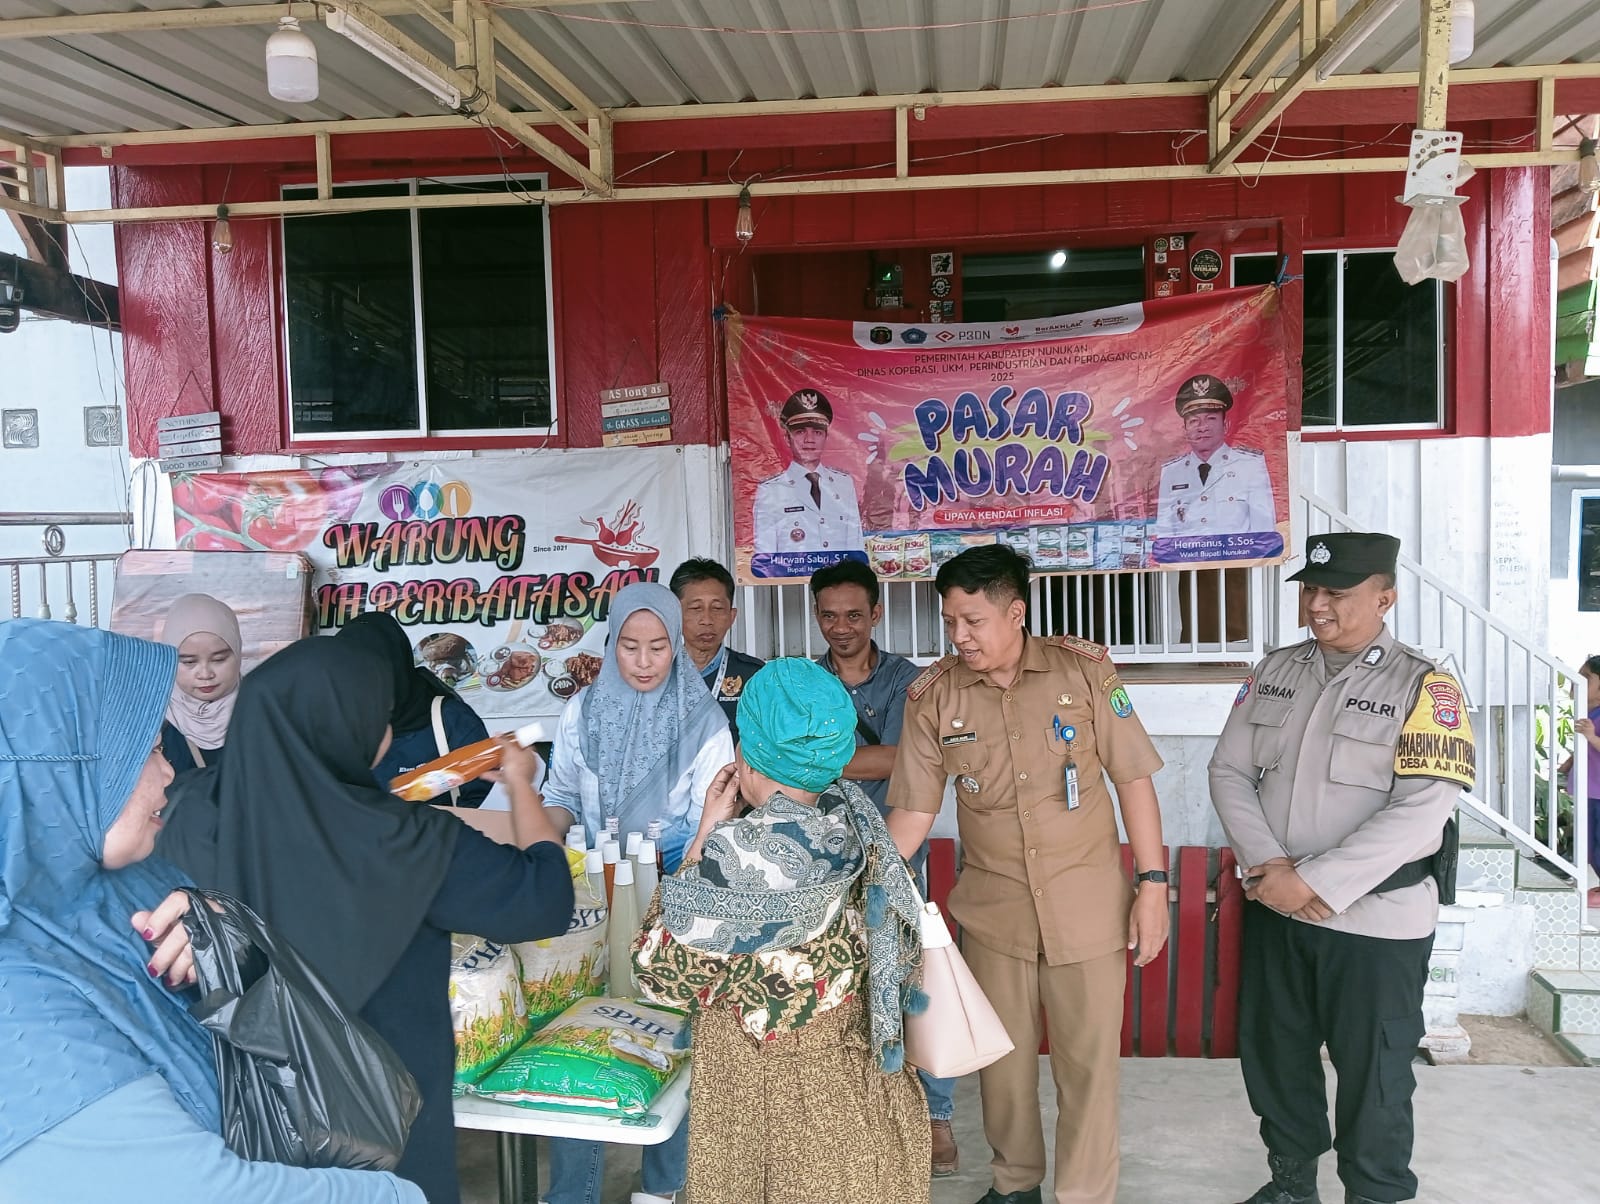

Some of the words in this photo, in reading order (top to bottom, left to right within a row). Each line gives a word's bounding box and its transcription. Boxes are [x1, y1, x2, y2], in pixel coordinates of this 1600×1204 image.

[958, 330, 991, 341] P3DN
[914, 353, 975, 364] PEMERINTAH
[978, 348, 1035, 361] KABUPATEN
[1038, 344, 1088, 356] NUNUKAN
[857, 367, 886, 377] DINAS
[888, 365, 939, 376] KOPERASI,
[969, 358, 1047, 371] PERINDUSTRIAN
[1050, 356, 1071, 366] DAN
[1074, 351, 1153, 364] PERDAGANGAN
[991, 372, 1014, 382] 2025
[624, 387, 648, 397] long
[650, 385, 662, 394] as
[615, 417, 640, 429] GRASS
[914, 385, 1094, 452] PASAR
[163, 462, 185, 471] GOOD
[187, 459, 208, 468] FOOD
[904, 443, 1112, 511] MURAH
[944, 510, 976, 521] UPAYA
[978, 509, 1021, 520] KENDALI
[1024, 508, 1063, 518] INFLASI
[323, 515, 526, 572] WARUNG
[1174, 539, 1226, 550] Hermanus,
[1227, 536, 1255, 546] S.Sos
[1179, 551, 1199, 559] Wakil
[1200, 550, 1221, 559] Bupati
[1222, 548, 1250, 557] Nunukan
[787, 566, 807, 575] Bupati
[1257, 683, 1296, 700] USMAN
[1345, 697, 1396, 718] POLRI
[1400, 758, 1428, 769] DESA
[1434, 760, 1451, 771] AJI
[592, 1005, 675, 1036] SPHP
